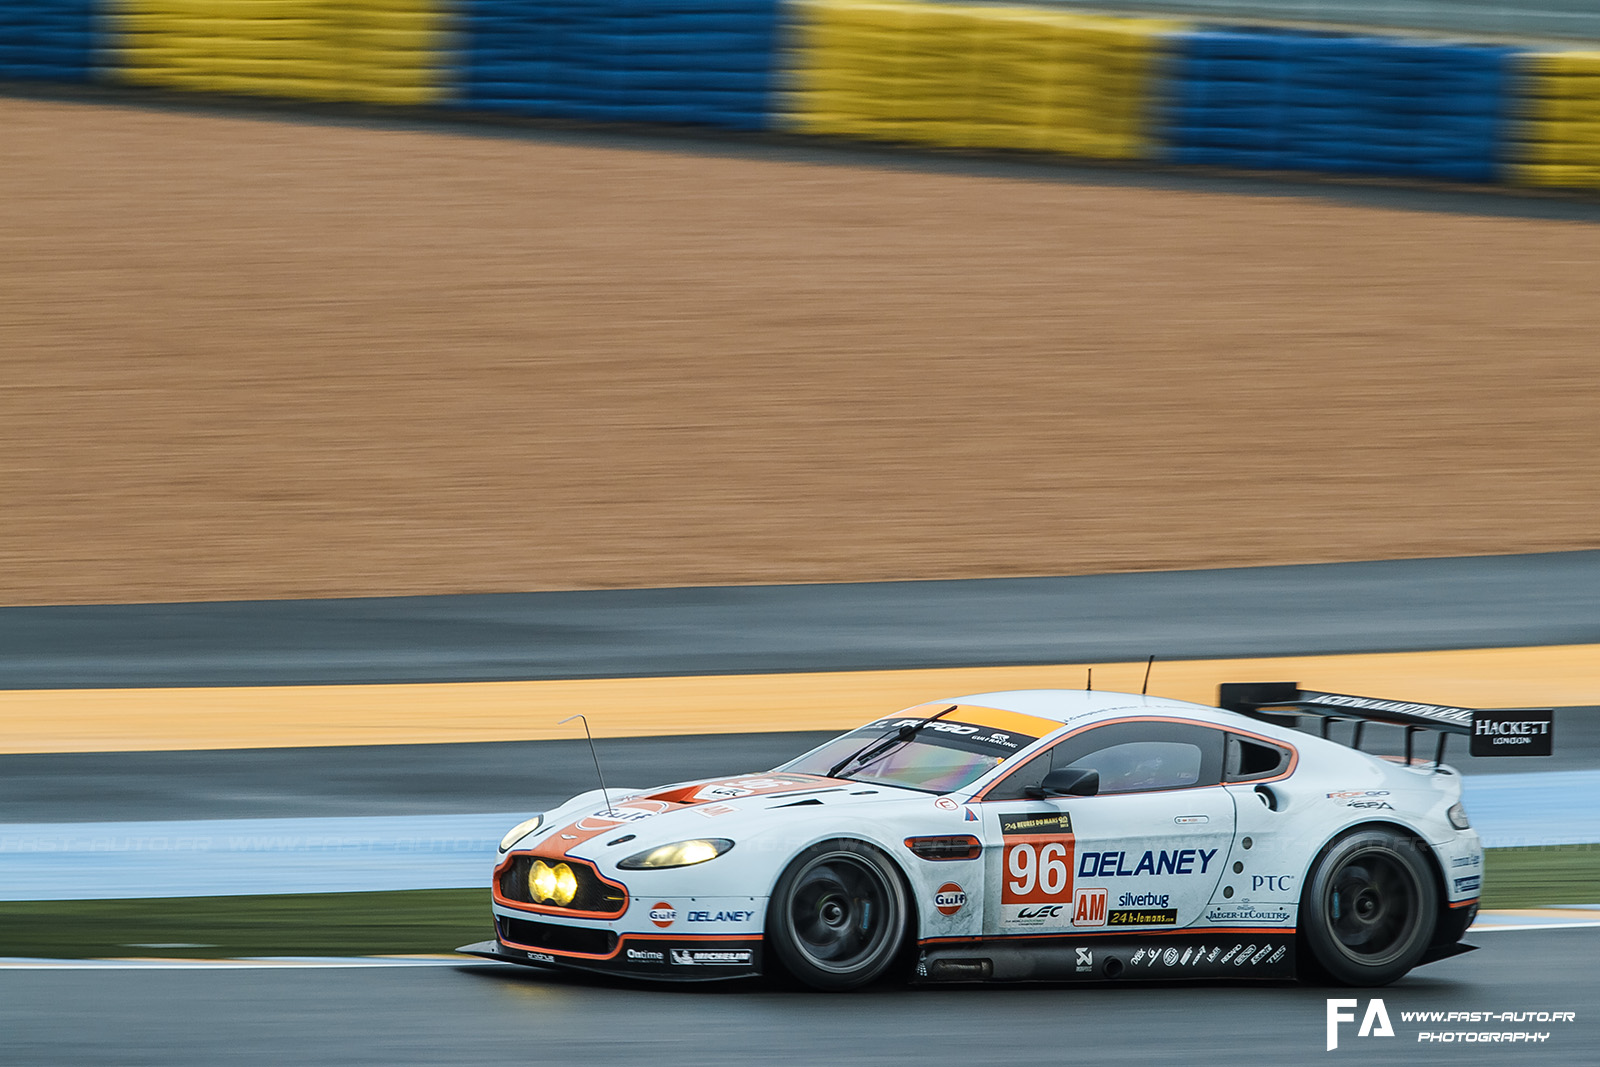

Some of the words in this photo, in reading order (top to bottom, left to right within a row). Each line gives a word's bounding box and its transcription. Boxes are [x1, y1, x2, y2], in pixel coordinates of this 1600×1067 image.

[1475, 719, 1551, 736] HACKETT
[1004, 822, 1017, 831] 24
[1008, 843, 1067, 896] 96
[1078, 849, 1218, 877] DELANEY
[1252, 875, 1291, 892] PTC
[935, 892, 965, 905] Gulf
[1118, 892, 1169, 908] silverbug
[649, 910, 677, 920] Gulf
[1018, 905, 1063, 918] WEC
[1076, 894, 1105, 920] AM
[687, 911, 754, 922] DELANEY
